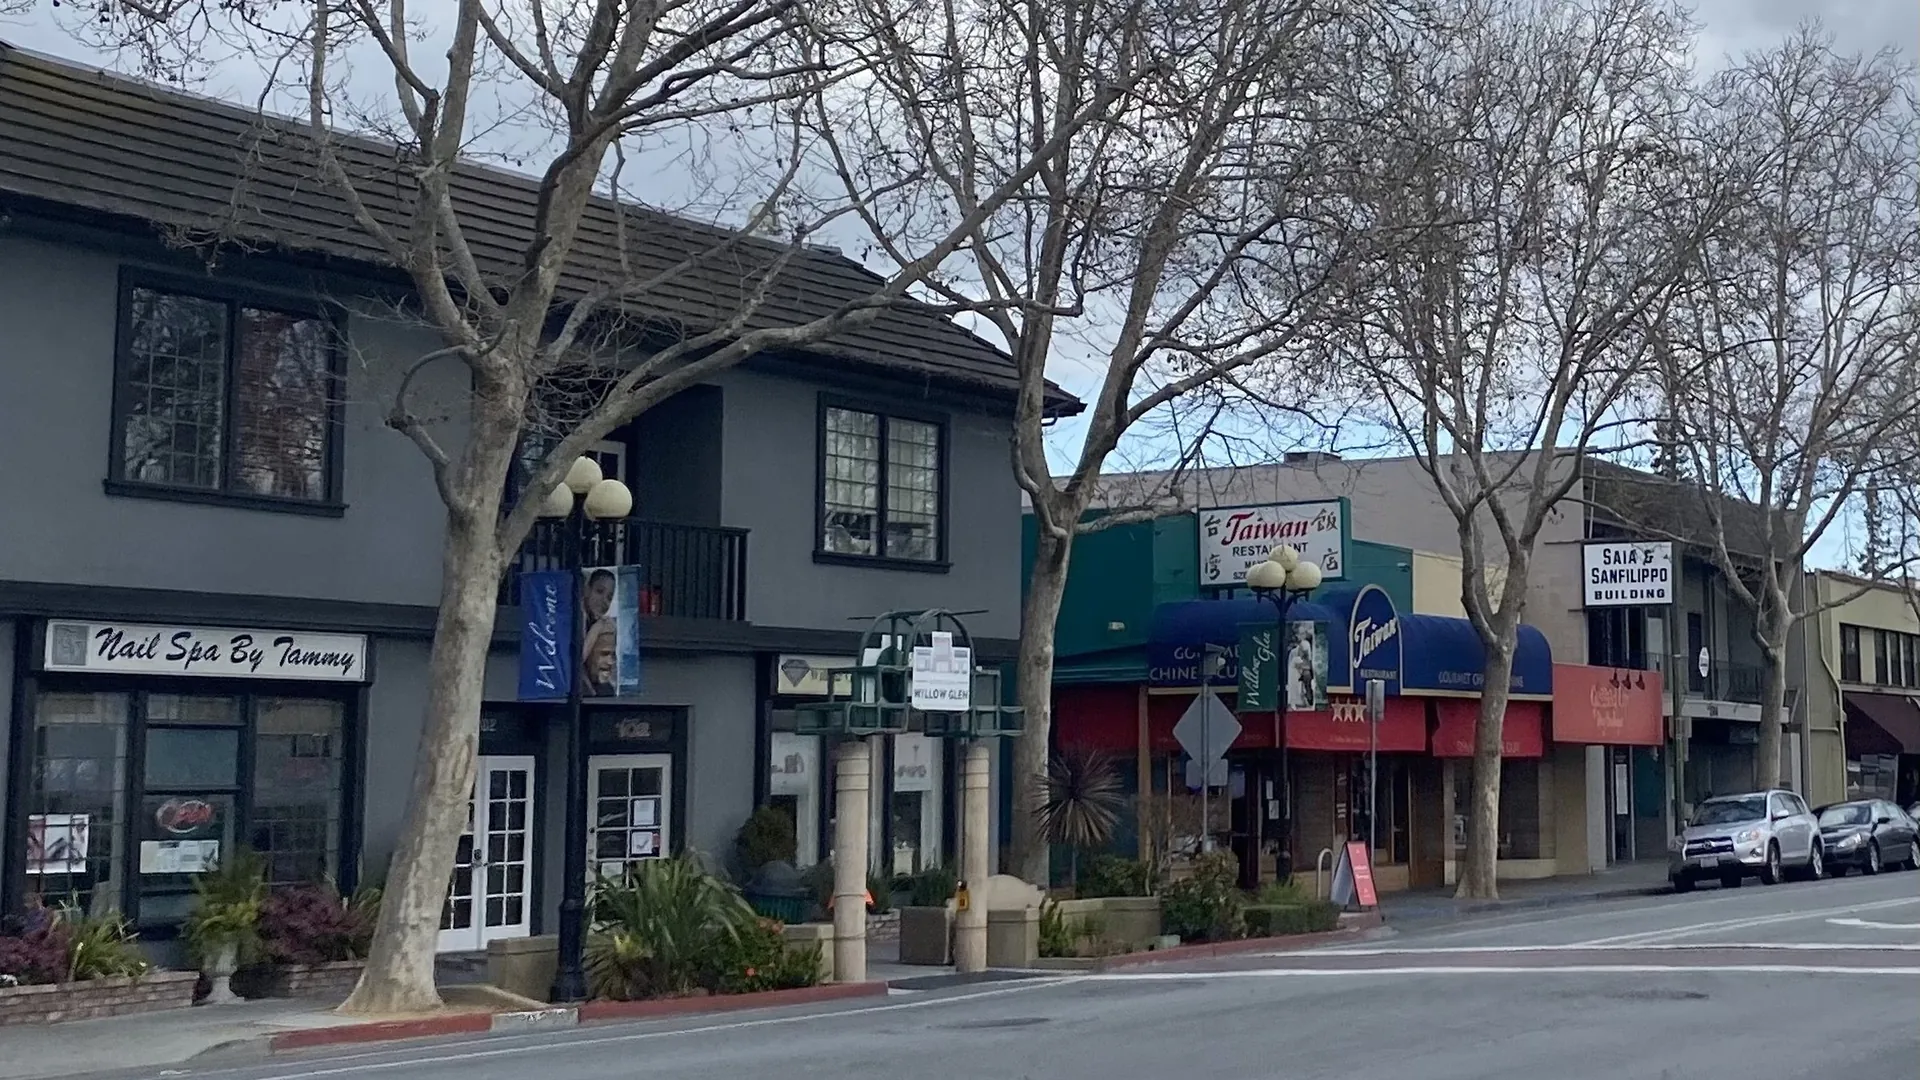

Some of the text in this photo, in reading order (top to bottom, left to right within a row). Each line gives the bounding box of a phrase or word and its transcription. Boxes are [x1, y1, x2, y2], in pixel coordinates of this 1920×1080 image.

[1221, 512, 1309, 546] Taiwan
[1232, 541, 1309, 557] RESTANT
[1602, 548, 1655, 566] SAIA &
[1591, 567, 1668, 585] SANFILIPPO
[1594, 588, 1666, 601] BUILDING
[528, 584, 558, 690] Welcome
[1252, 629, 1277, 662] Glen
[1353, 616, 1397, 669] Taiwan
[95, 627, 356, 676] Nail Spa By Tammy
[914, 688, 968, 700] WILLOW GLEN
